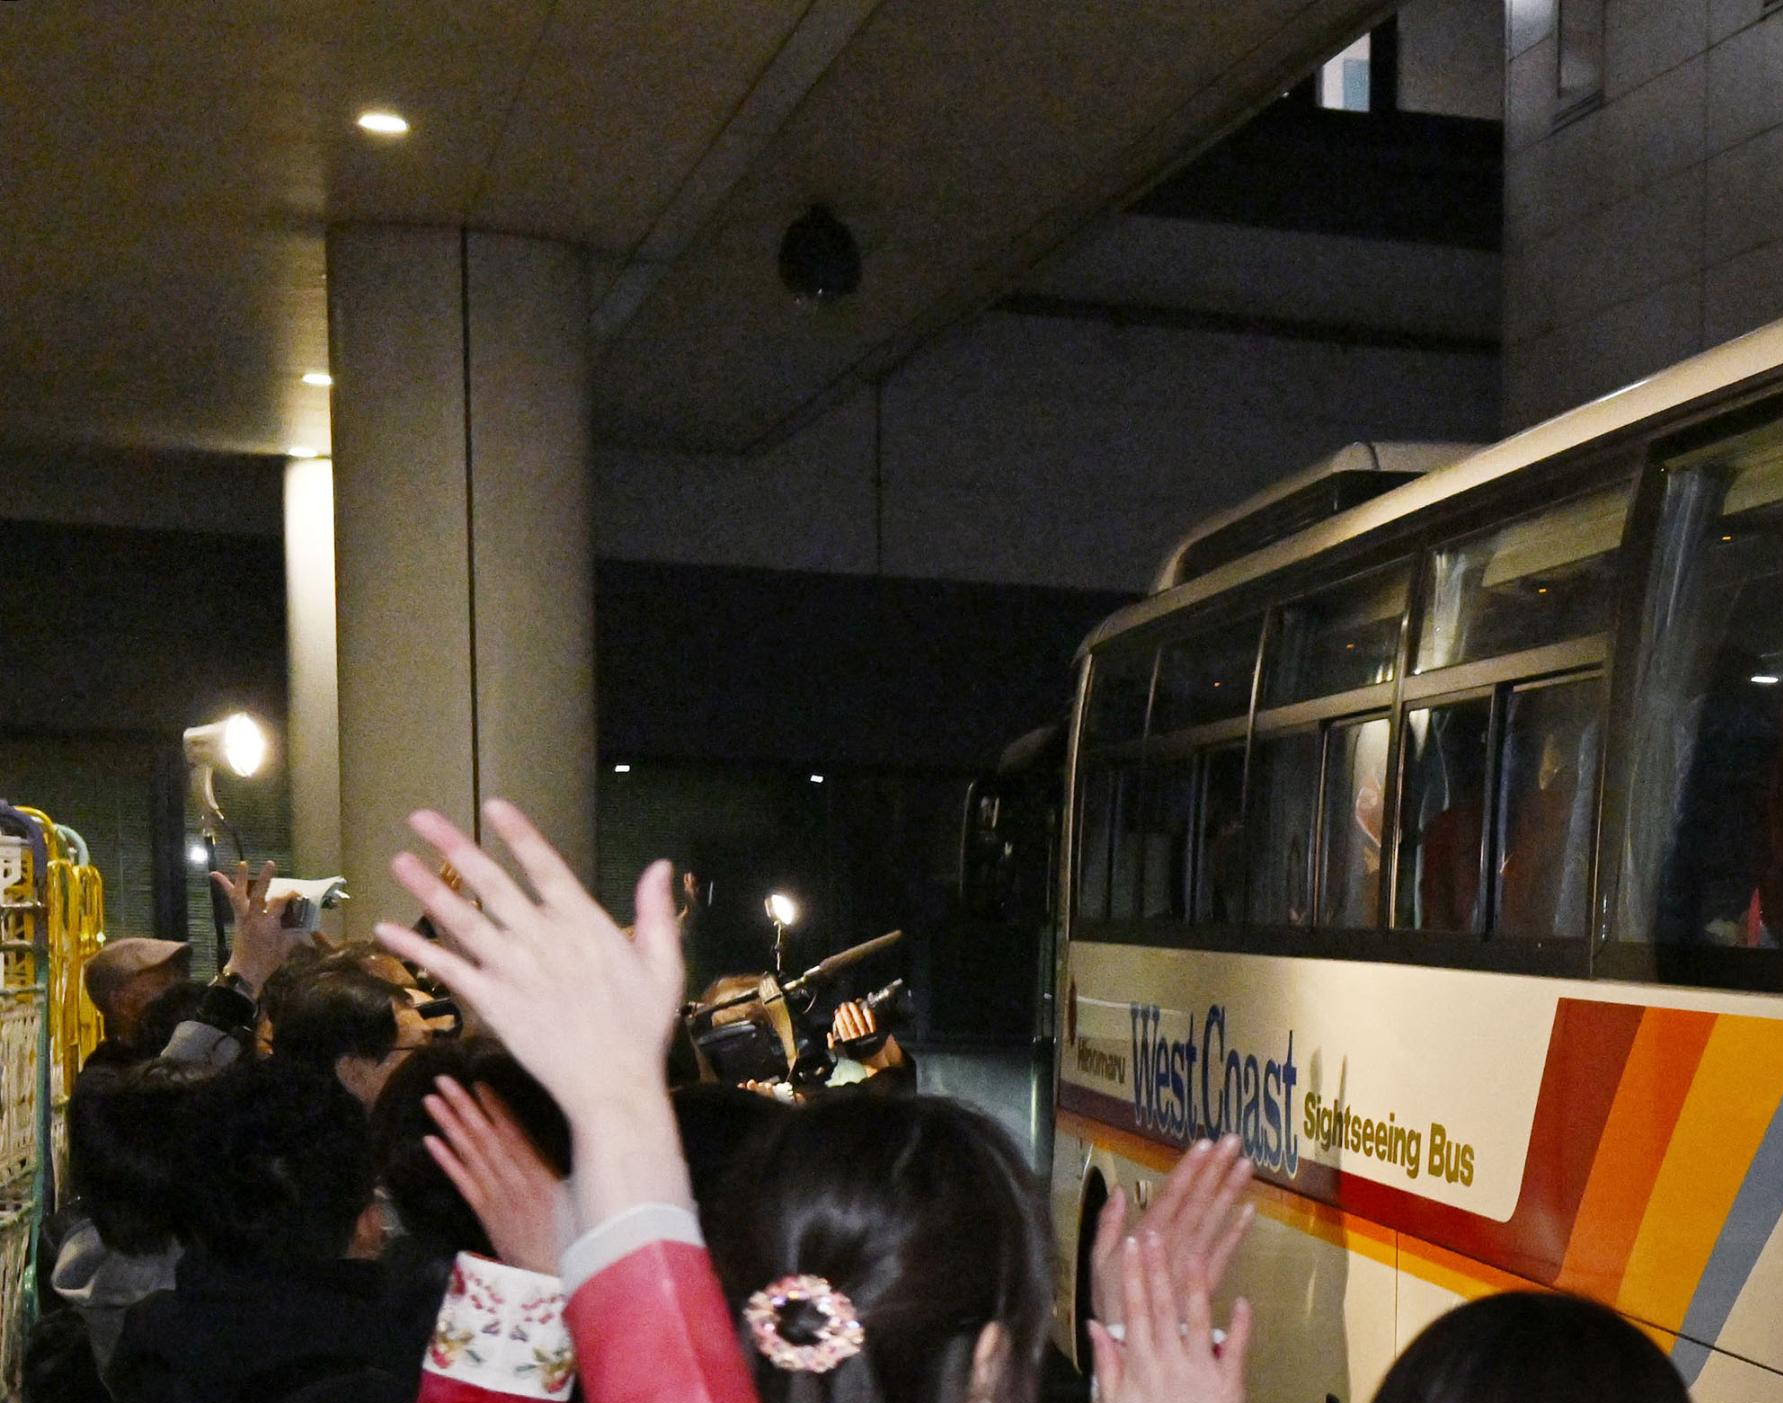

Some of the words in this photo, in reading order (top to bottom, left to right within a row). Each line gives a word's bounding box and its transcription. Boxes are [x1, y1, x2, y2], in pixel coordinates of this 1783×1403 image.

[1130, 1002, 1198, 1145] West
[1202, 1003, 1298, 1180] Coast
[1303, 1092, 1422, 1179] Sightseeing
[1428, 1122, 1475, 1187] Bus
